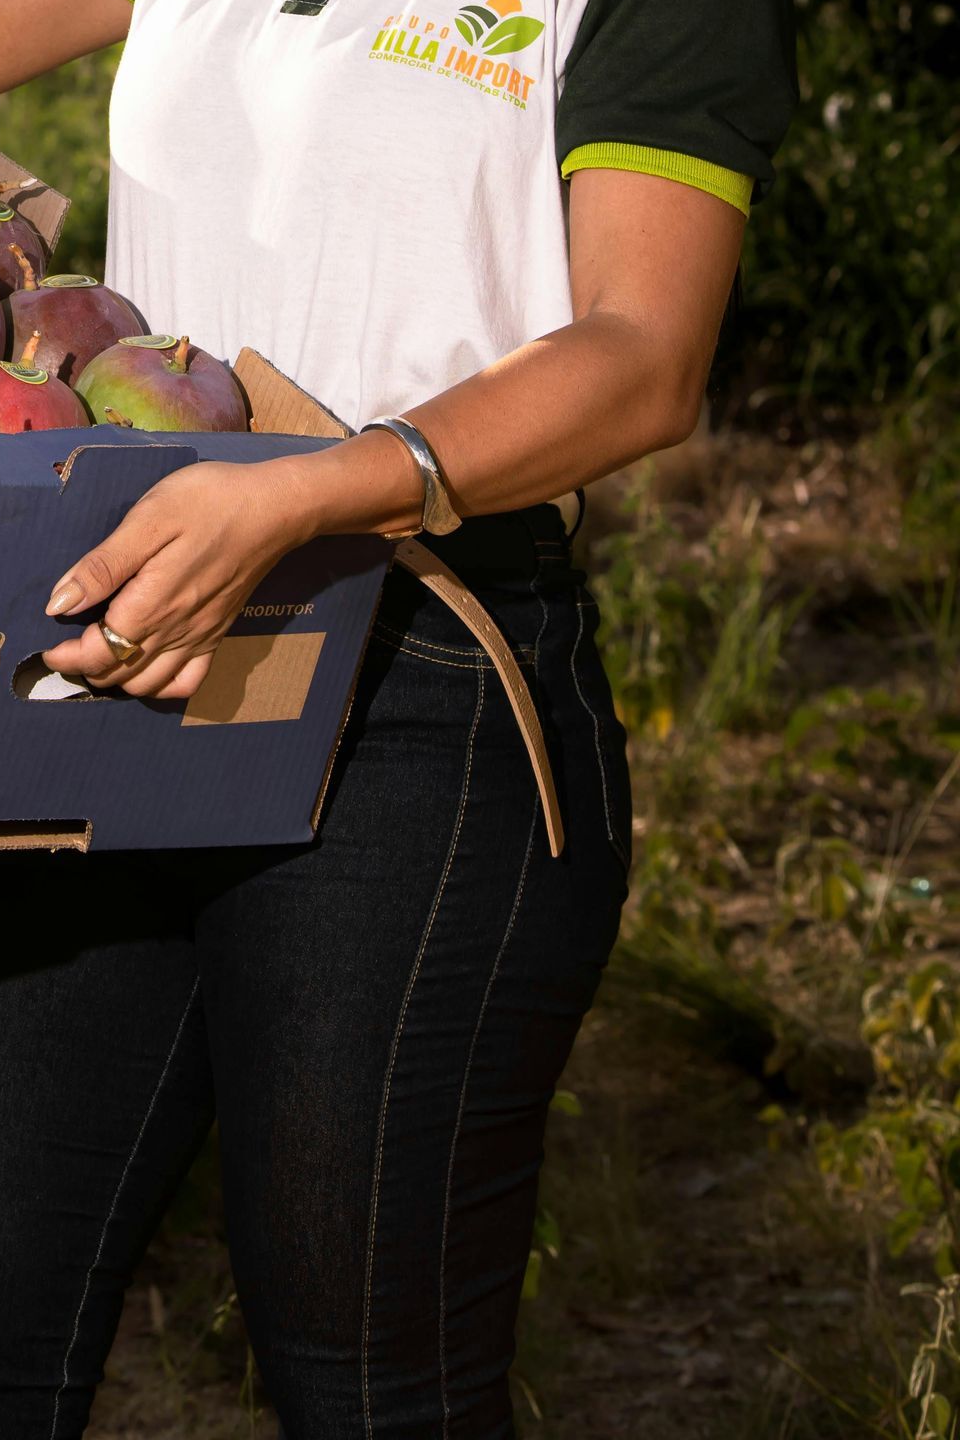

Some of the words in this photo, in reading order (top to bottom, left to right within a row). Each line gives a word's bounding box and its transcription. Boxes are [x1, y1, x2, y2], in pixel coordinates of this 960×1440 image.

[368, 52, 432, 72] COMERCIAL
[437, 67, 451, 78] DE
[455, 72, 500, 98] FRUTAS
[503, 92, 527, 111] LTDA
[444, 46, 535, 102] IMPORT
